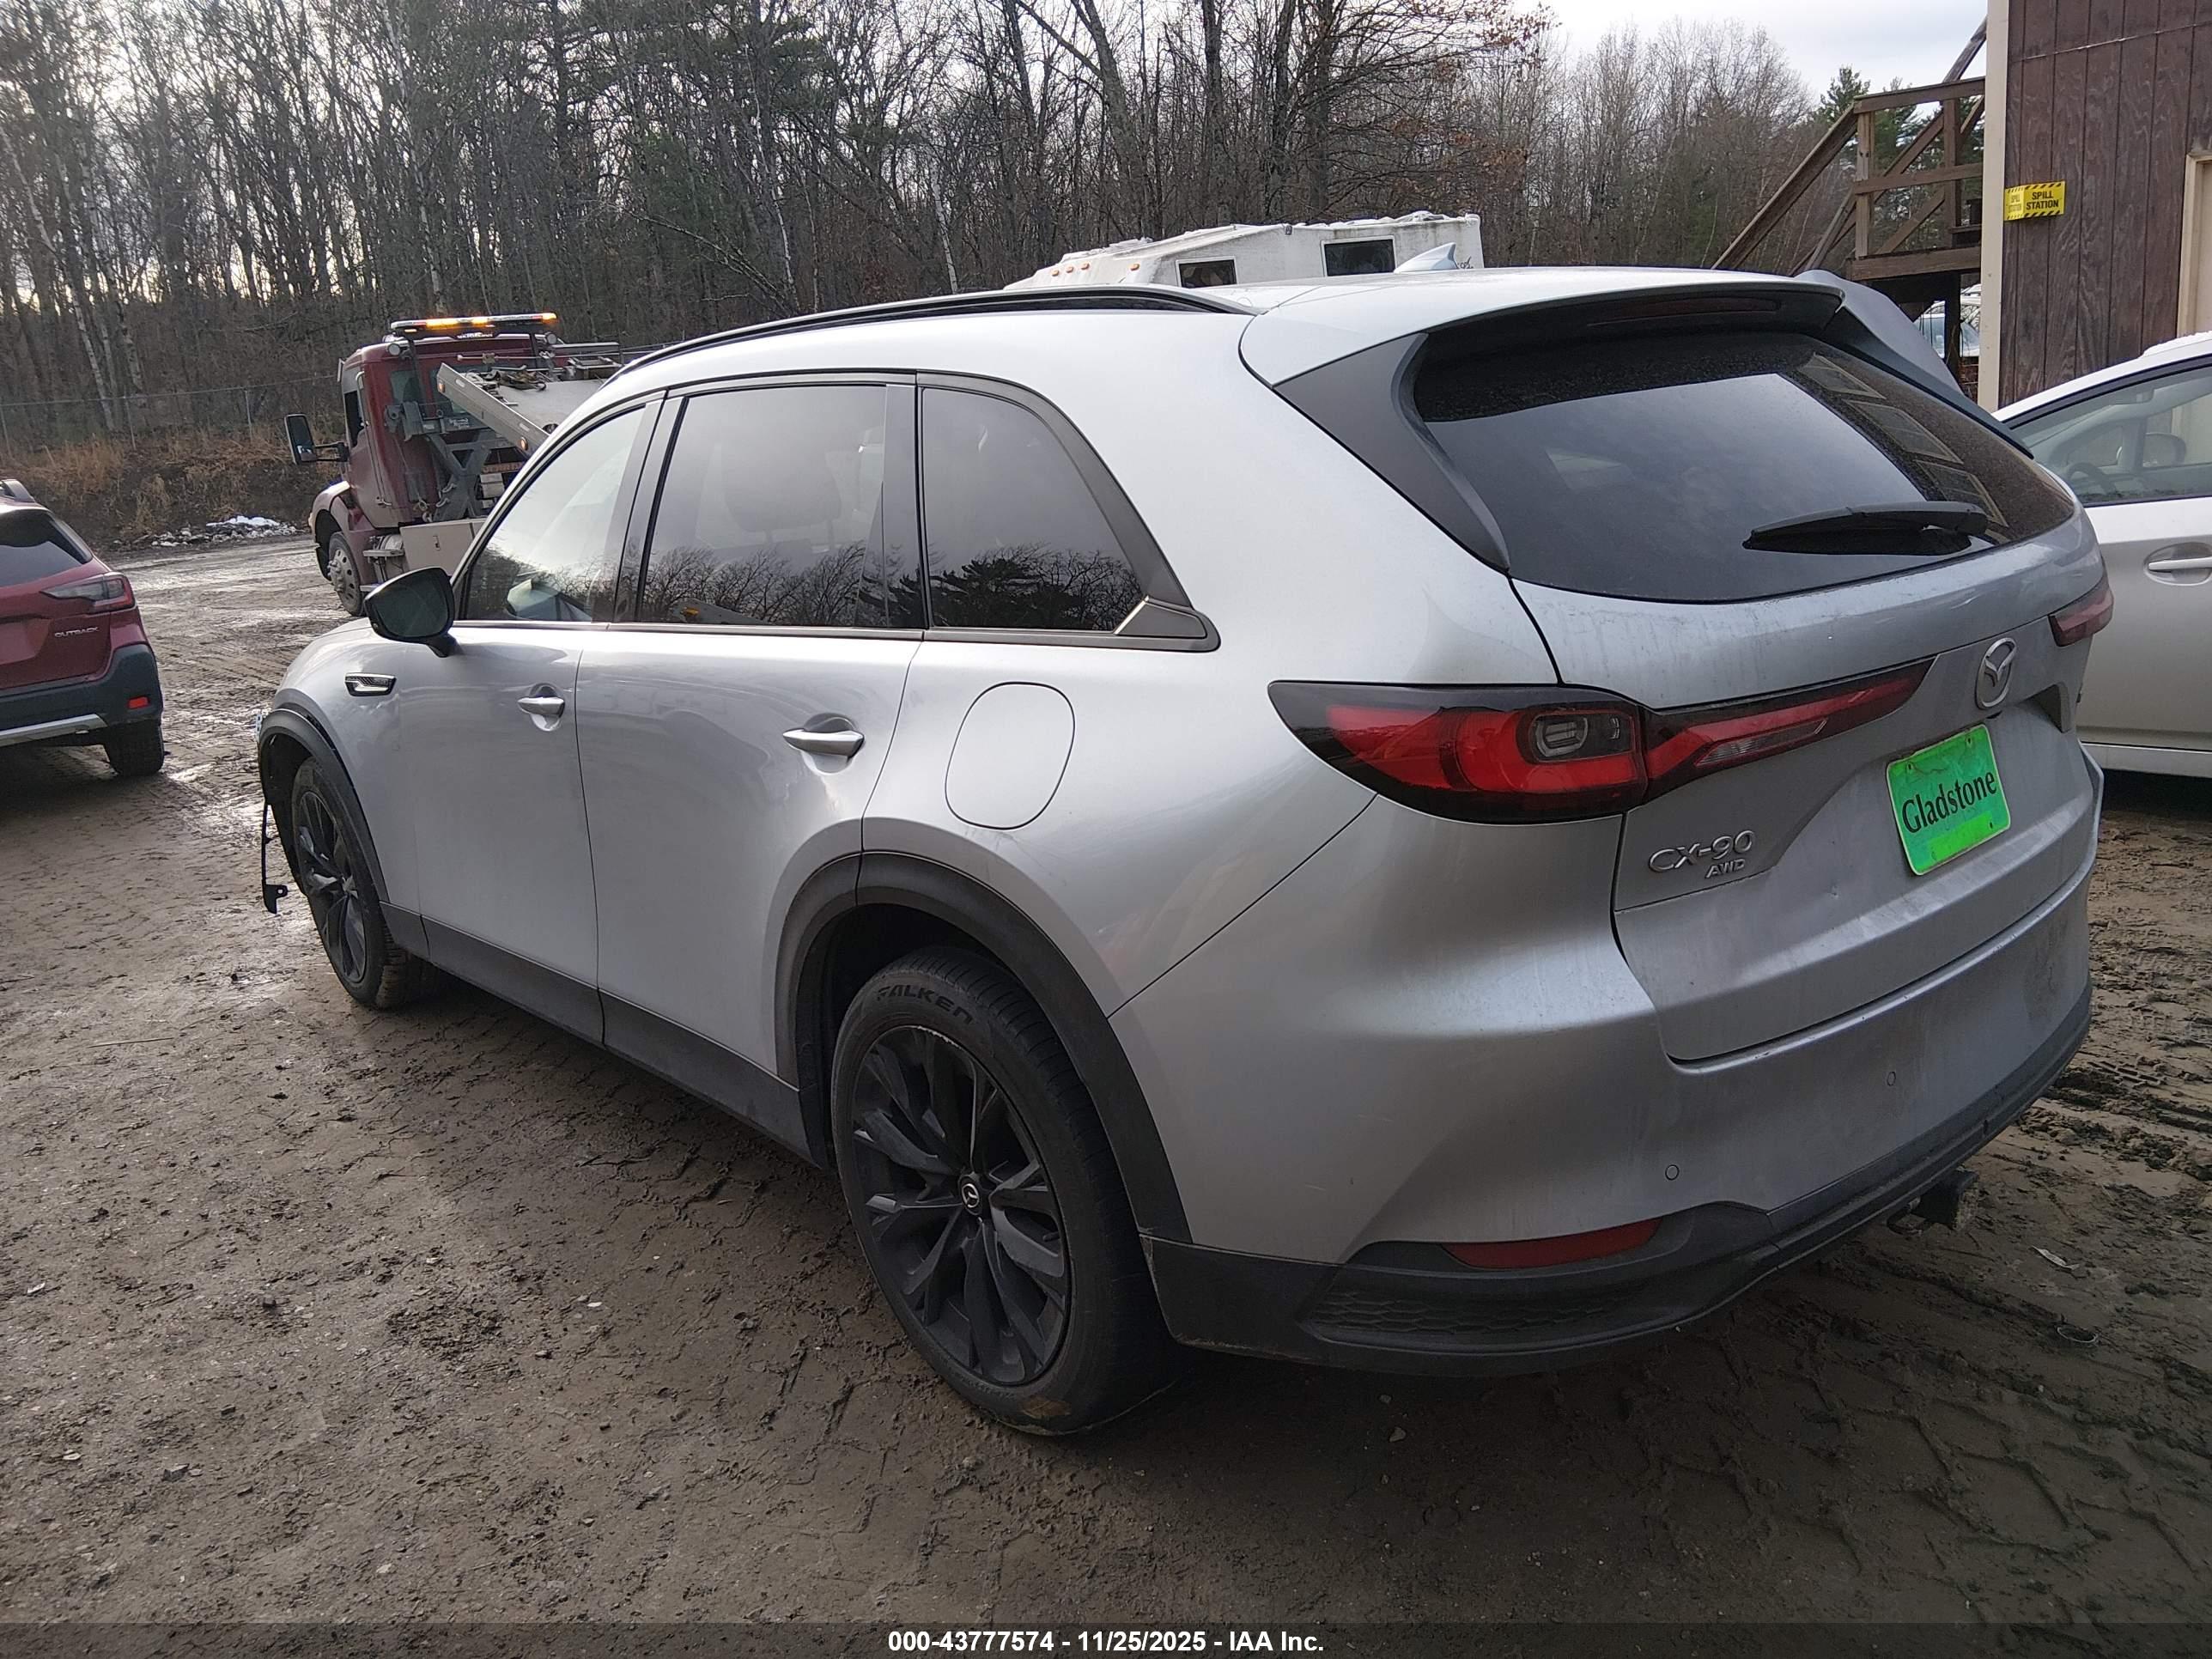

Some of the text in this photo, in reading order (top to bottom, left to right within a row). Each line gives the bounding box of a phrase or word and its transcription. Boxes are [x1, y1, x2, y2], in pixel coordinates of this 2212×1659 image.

[2027, 199, 2059, 210] STATION
[2032, 191, 2053, 200] SPILL
[55, 627, 100, 637] OUTBACK
[1901, 771, 1997, 834] Gladstone
[1649, 830, 1755, 872] CX-90
[1705, 859, 1746, 879] AWD
[876, 984, 975, 1025] FALKEN
